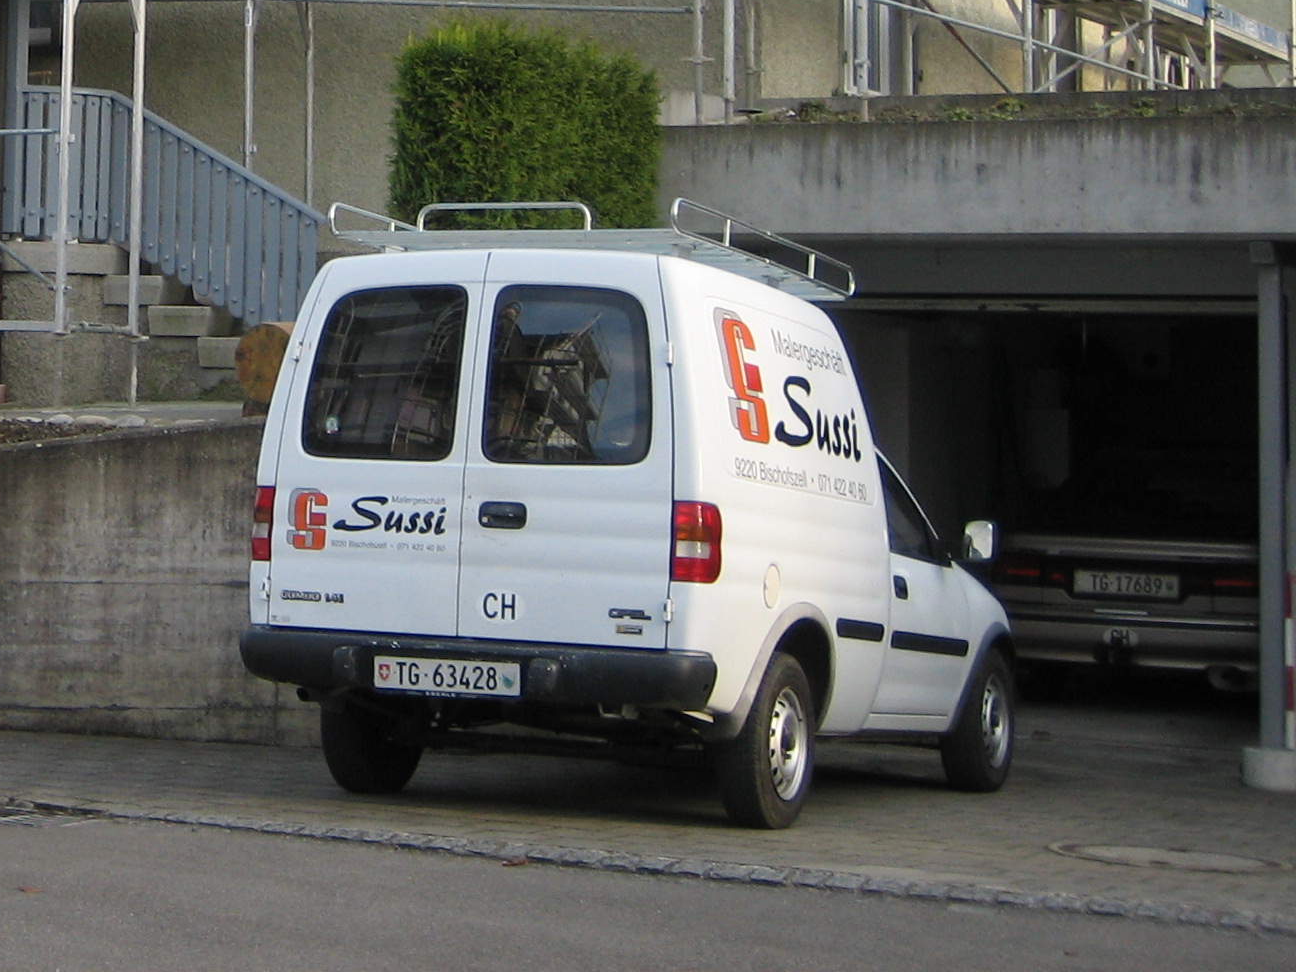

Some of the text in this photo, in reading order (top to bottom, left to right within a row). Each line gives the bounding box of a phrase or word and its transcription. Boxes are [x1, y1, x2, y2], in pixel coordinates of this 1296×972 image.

[770, 328, 847, 376] Malergeschäft
[775, 375, 862, 463] Sussi
[734, 457, 758, 480] 9220
[759, 461, 808, 488] Bischofszell
[818, 473, 832, 493] 071
[834, 477, 847, 496] 422
[849, 481, 857, 499] 40
[332, 495, 447, 536] Sussi
[391, 495, 446, 506] Malergeschäft
[483, 592, 516, 620] CH
